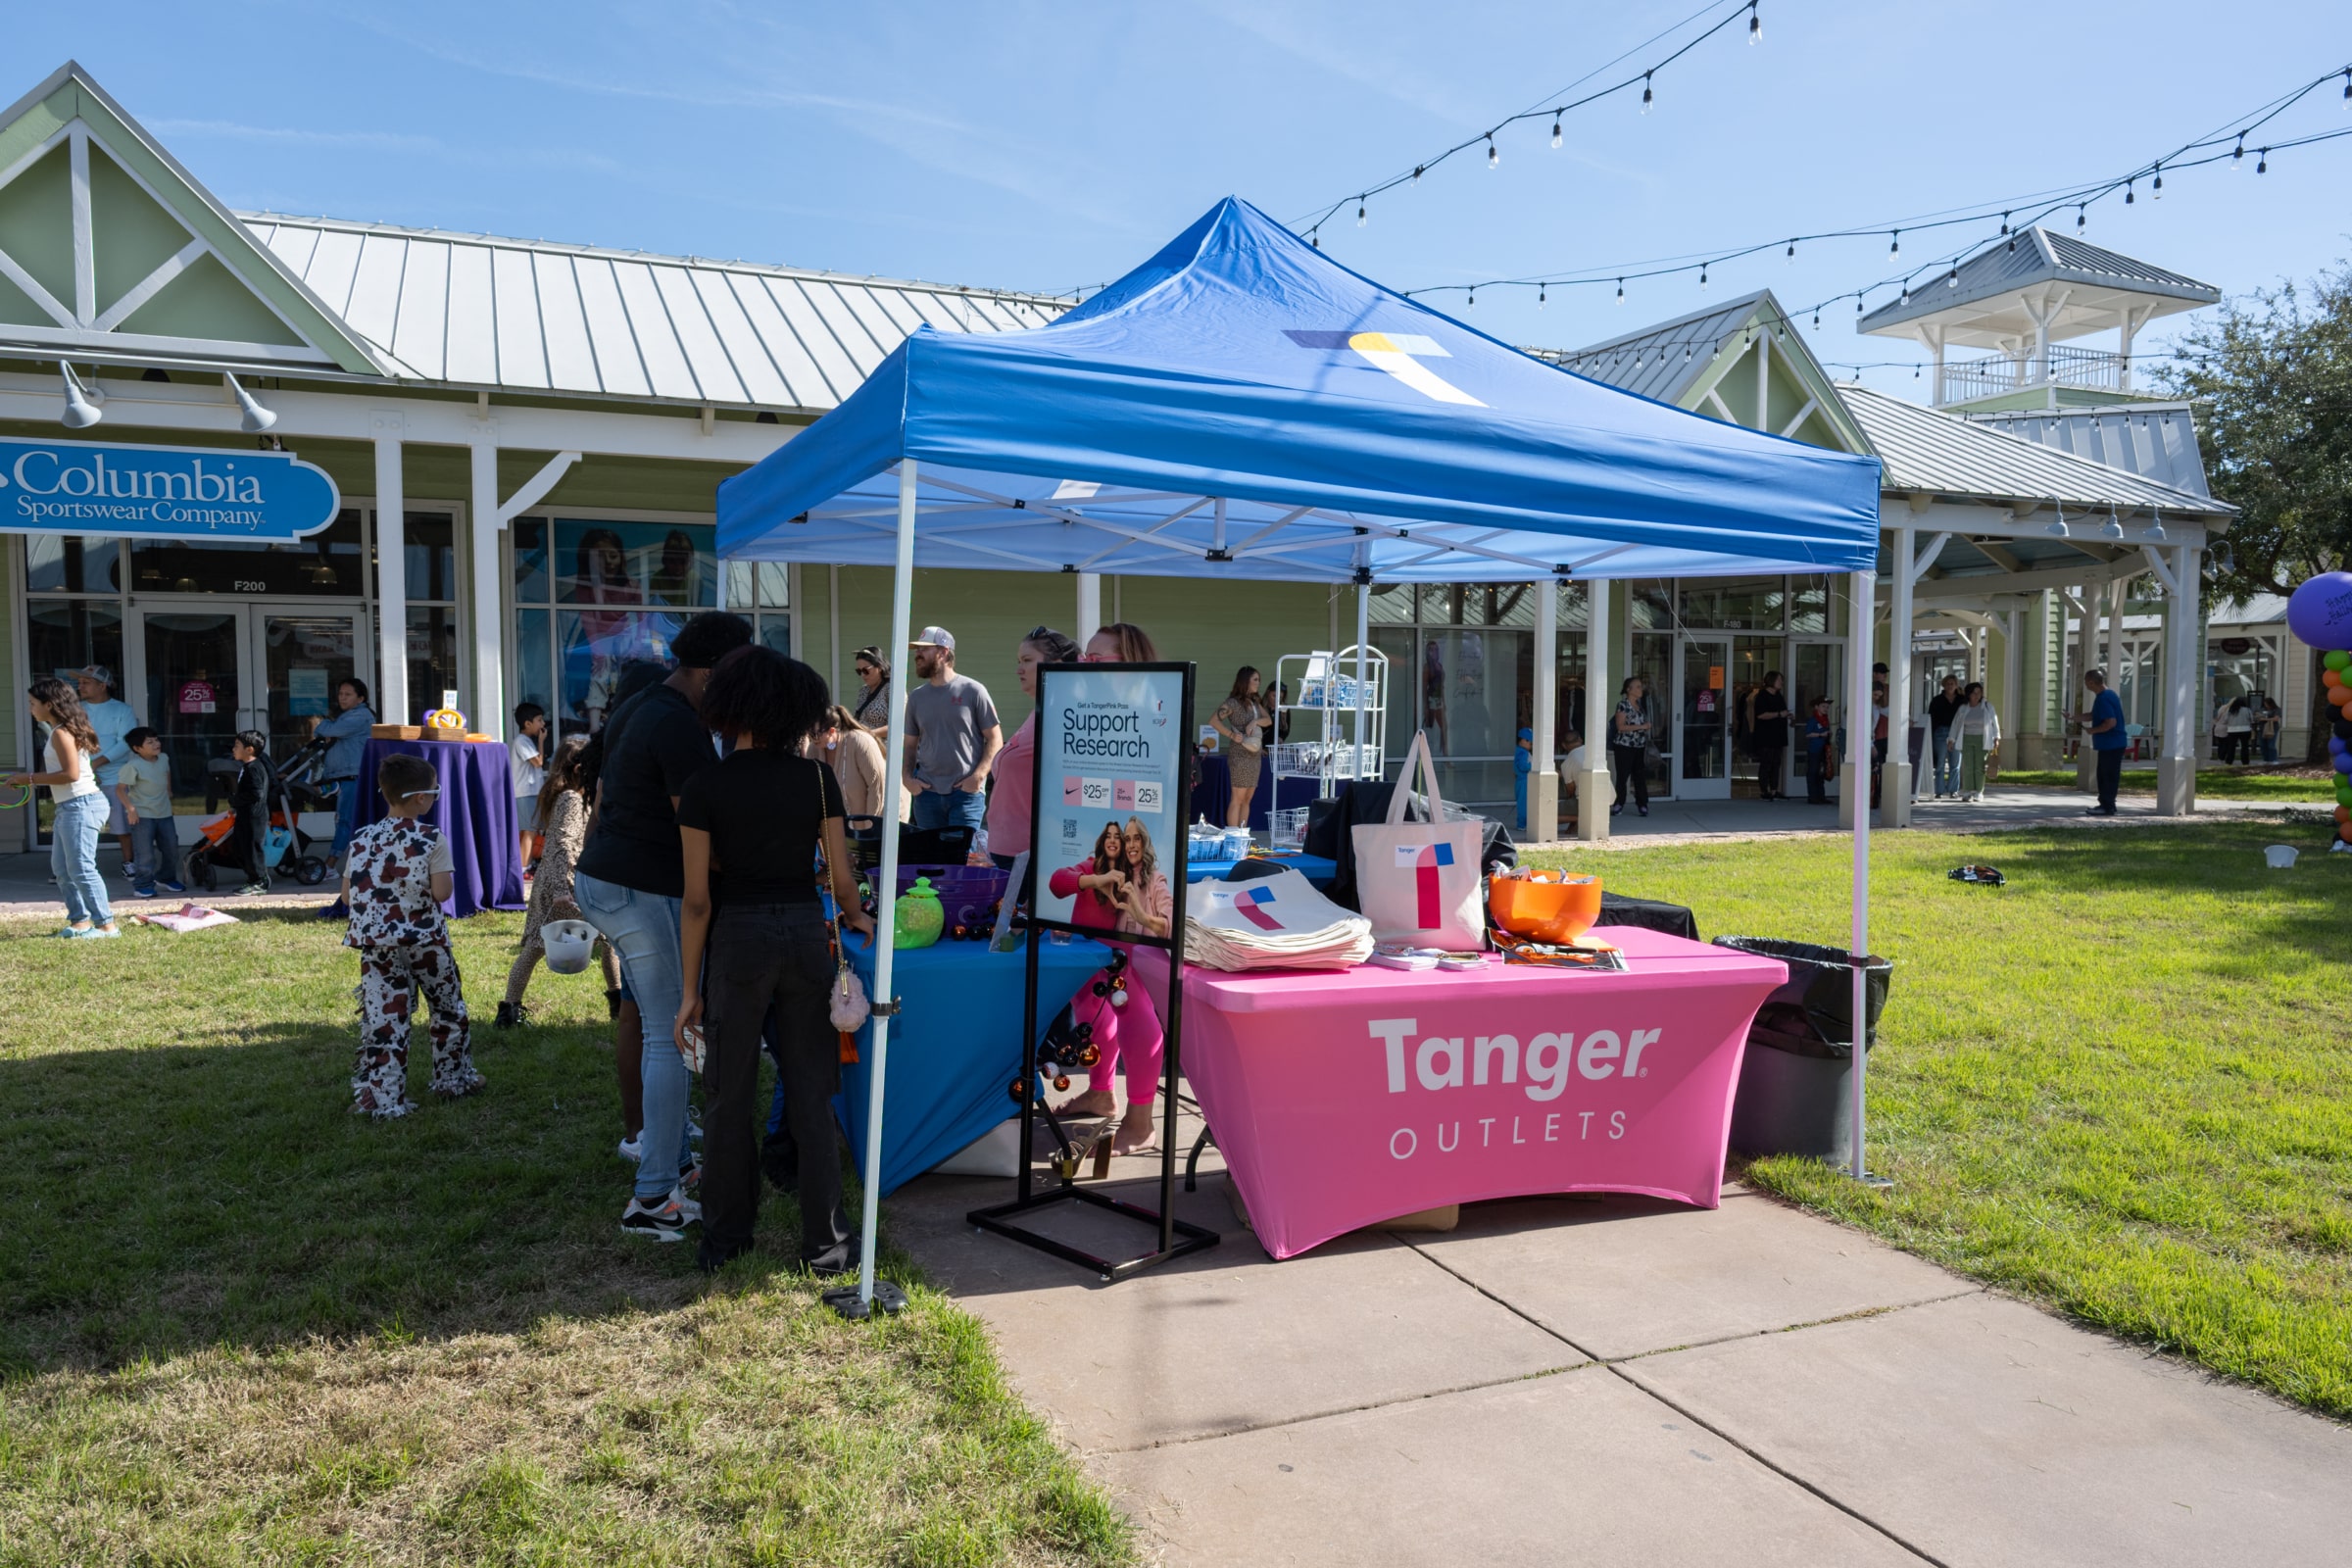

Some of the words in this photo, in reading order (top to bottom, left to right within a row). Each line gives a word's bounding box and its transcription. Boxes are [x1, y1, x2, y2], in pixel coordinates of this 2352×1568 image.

[13, 450, 266, 505] Columbia
[17, 495, 149, 522] Sportswear
[234, 580, 266, 592] F200
[1063, 708, 1139, 737] Support
[1063, 732, 1150, 759] Research
[1083, 784, 1102, 799] $25
[1389, 1110, 1627, 1160] OUTLETS
